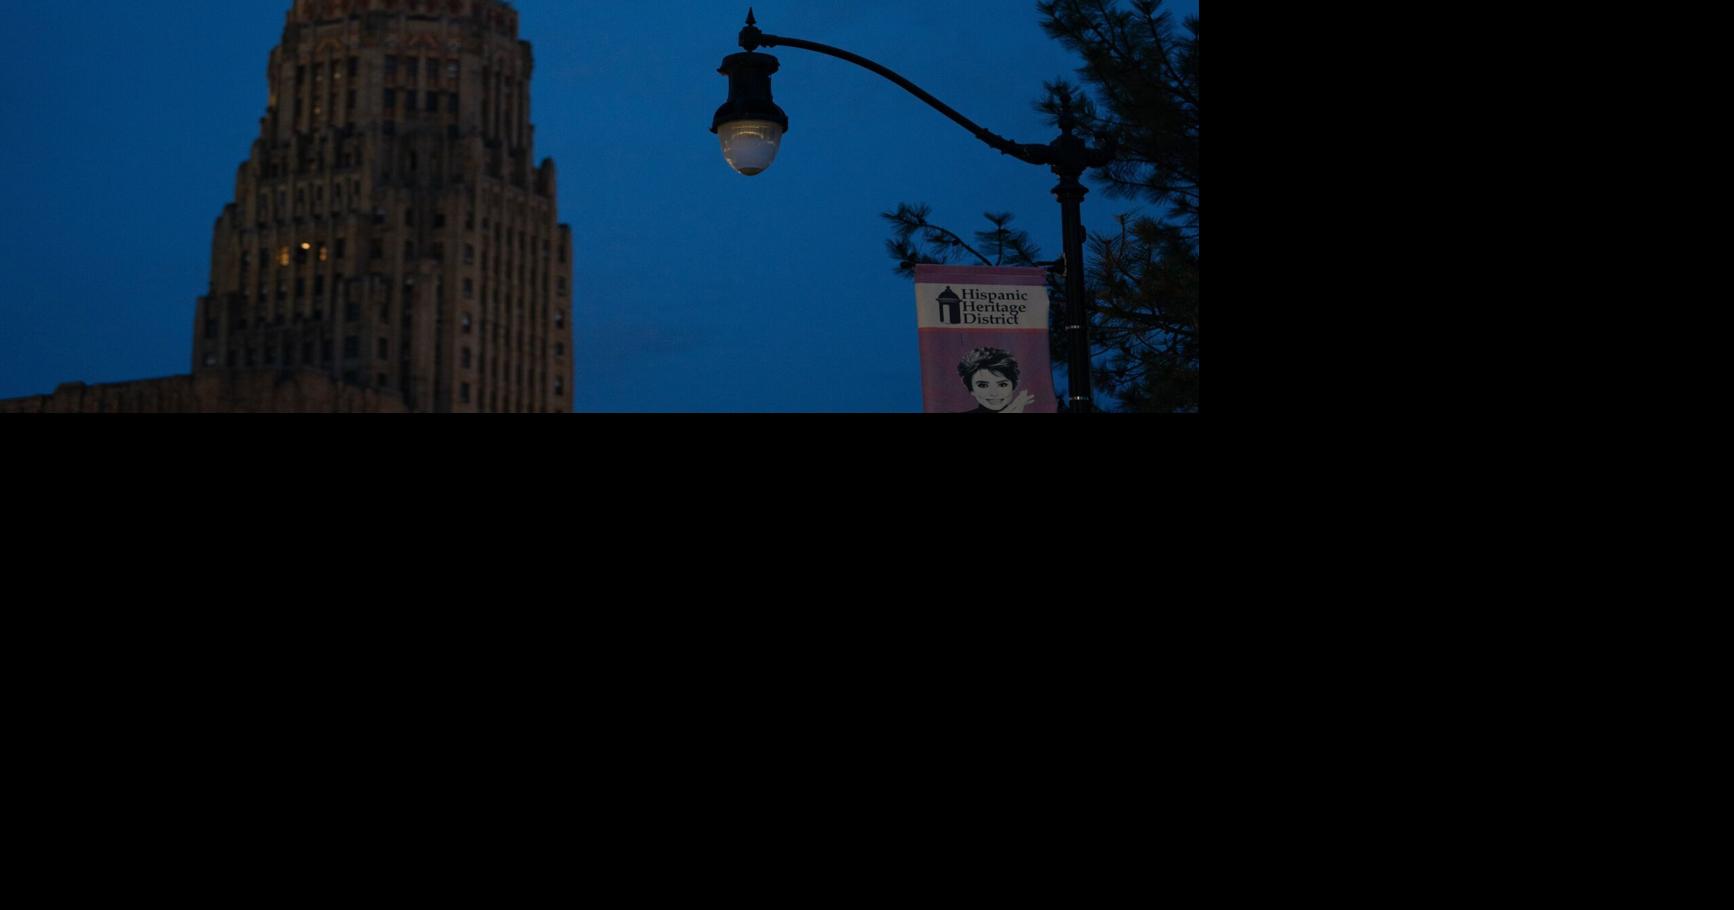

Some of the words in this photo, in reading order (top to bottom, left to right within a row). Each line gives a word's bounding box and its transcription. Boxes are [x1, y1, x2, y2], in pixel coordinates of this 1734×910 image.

[962, 288, 1028, 303] Hispanic
[962, 302, 1026, 315] Heritage
[964, 313, 1019, 325] District
